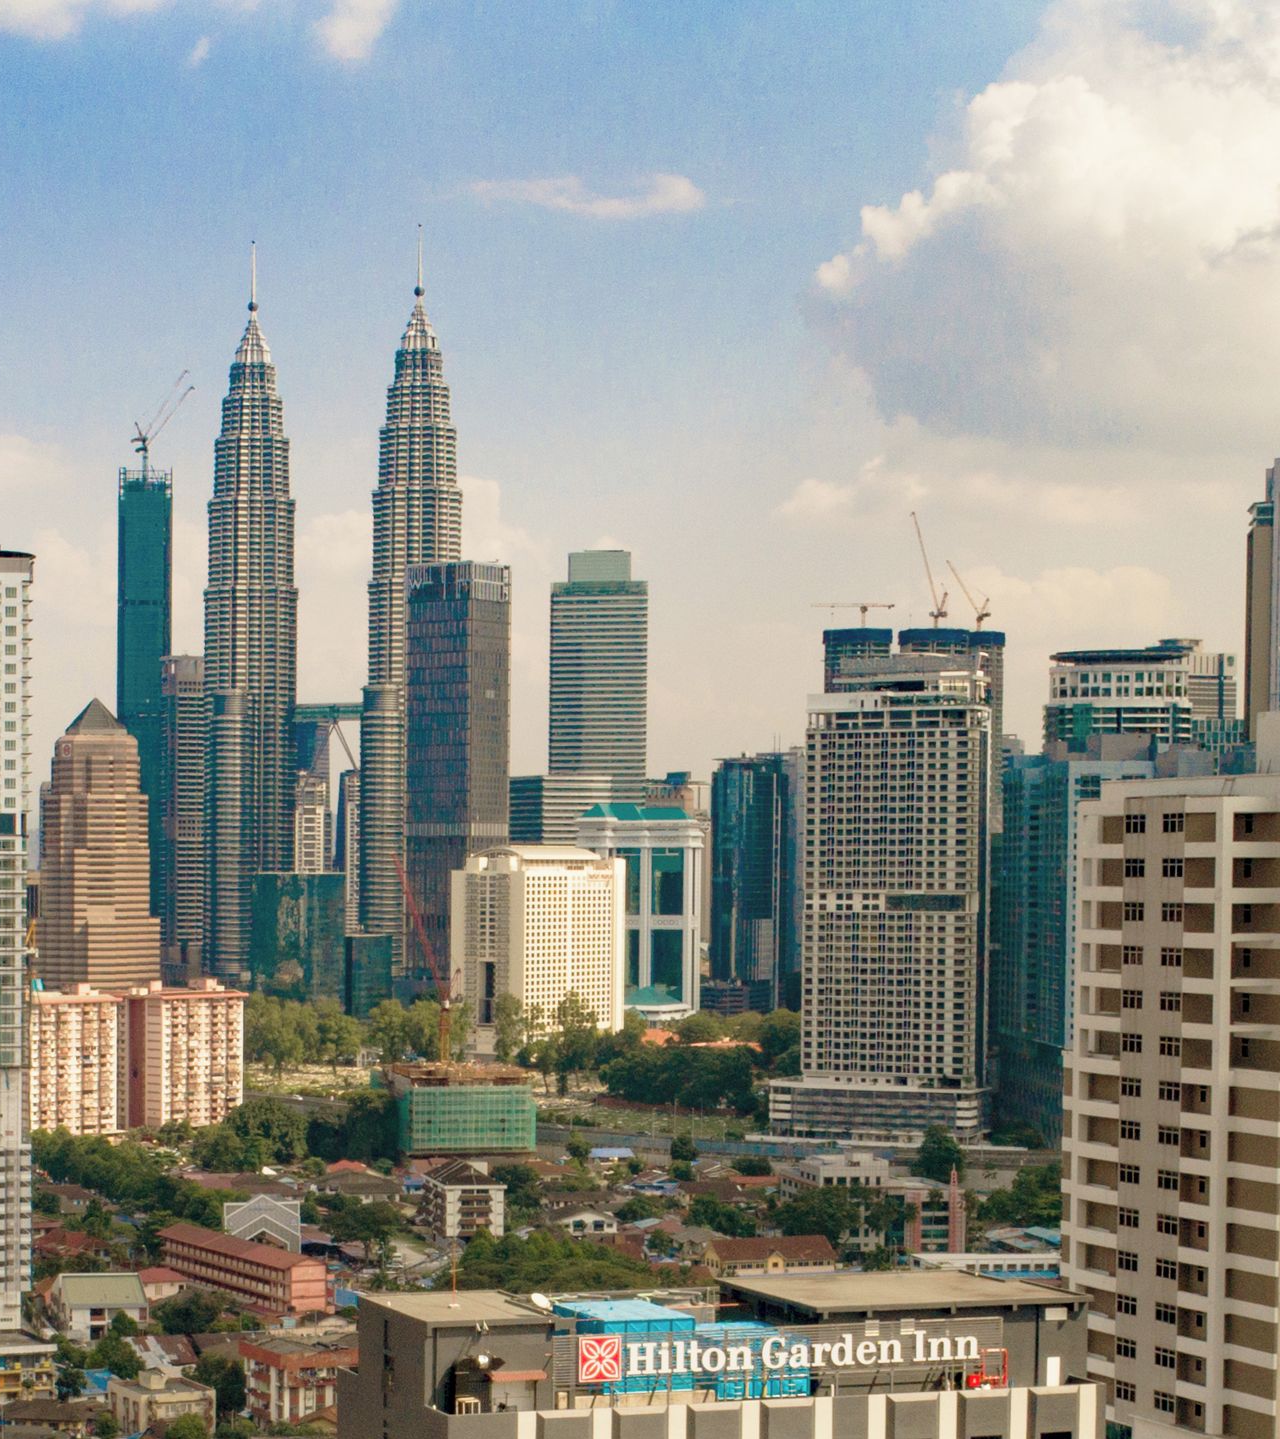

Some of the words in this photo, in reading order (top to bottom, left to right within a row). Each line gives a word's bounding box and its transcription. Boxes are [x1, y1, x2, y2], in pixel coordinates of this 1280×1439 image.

[626, 1338, 754, 1376] Hilton
[762, 1333, 905, 1370] Garden
[912, 1330, 980, 1363] Inn
